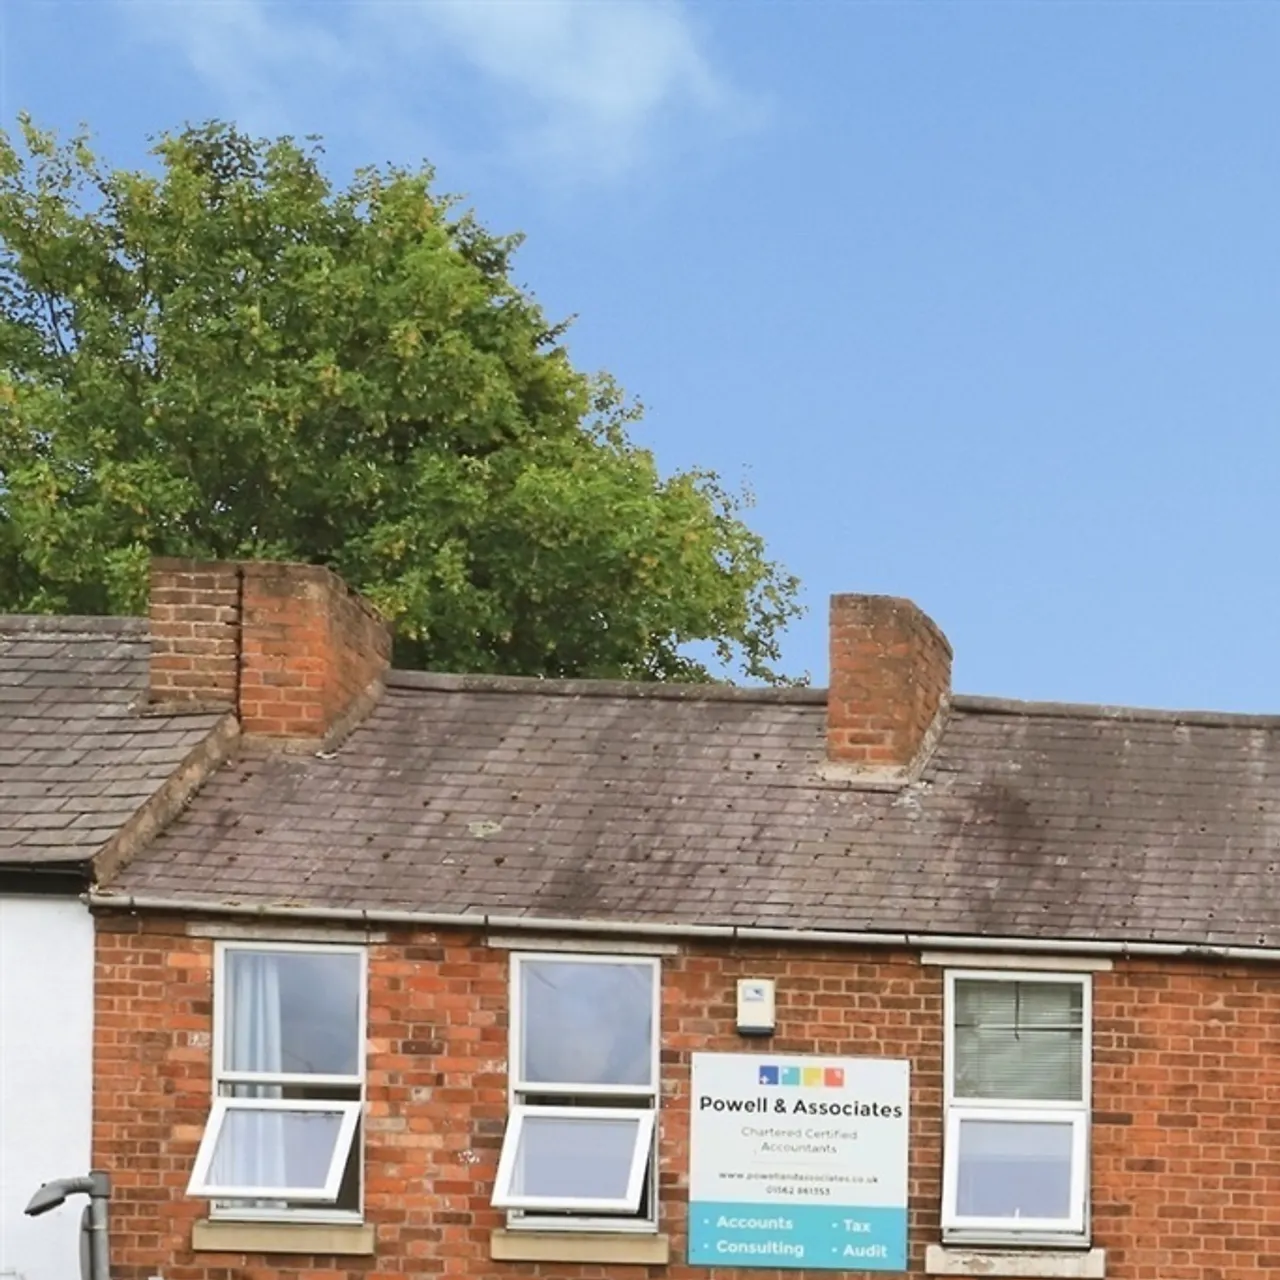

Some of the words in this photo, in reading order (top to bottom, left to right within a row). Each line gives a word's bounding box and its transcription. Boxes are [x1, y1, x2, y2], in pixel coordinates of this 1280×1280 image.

[700, 1095, 767, 1113] Powell
[774, 1099, 787, 1114] &
[793, 1100, 903, 1119] Associates
[741, 1127, 801, 1138] Chartered
[805, 1128, 858, 1140] Certified
[761, 1141, 837, 1154] Accountants
[716, 1215, 793, 1230] Accounts
[843, 1218, 871, 1233] Tax
[716, 1240, 804, 1258] Consulting
[843, 1244, 888, 1258] Audit
